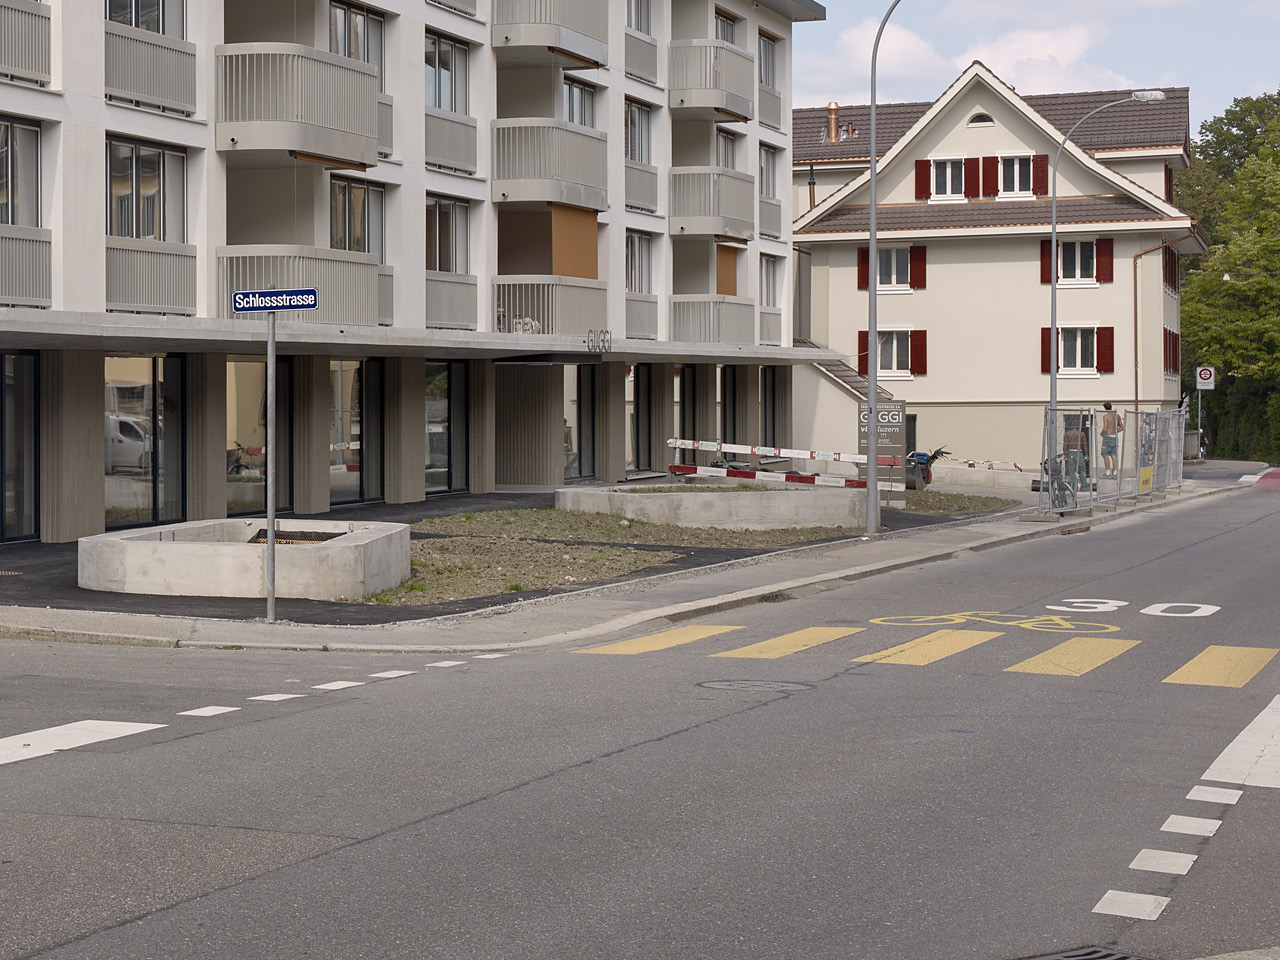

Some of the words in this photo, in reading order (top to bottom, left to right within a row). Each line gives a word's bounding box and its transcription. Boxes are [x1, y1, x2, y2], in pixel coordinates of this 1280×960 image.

[235, 293, 315, 308] Schlossstrasse
[587, 329, 612, 352] GUGGI
[860, 411, 902, 423] GGGI
[877, 425, 900, 433] luzern
[1045, 598, 1222, 617] 30
